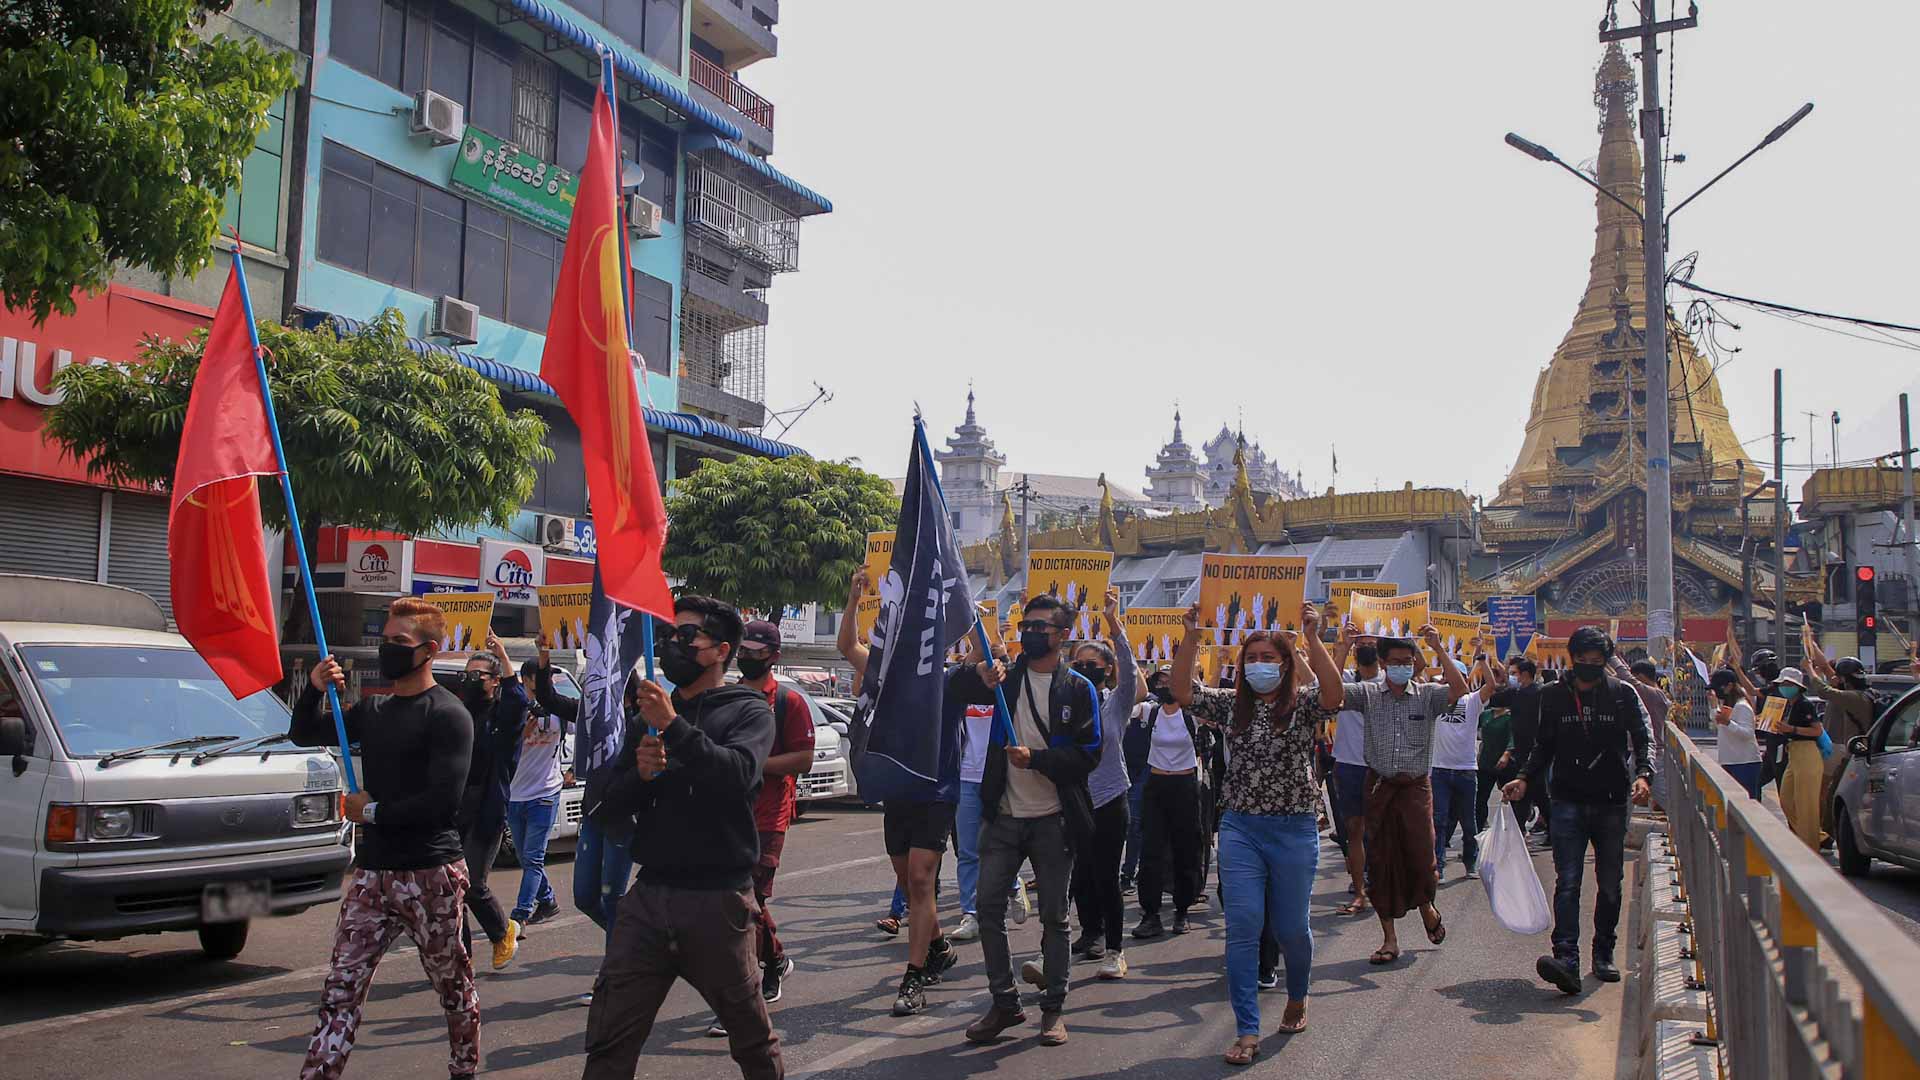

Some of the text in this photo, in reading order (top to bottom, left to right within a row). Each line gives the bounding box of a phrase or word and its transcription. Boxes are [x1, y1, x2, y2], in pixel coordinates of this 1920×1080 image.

[868, 540, 880, 553] NO
[360, 553, 390, 573] City
[1030, 559, 1110, 571] NO DICTATORSHIP
[496, 561, 533, 590] City
[1204, 564, 1304, 580] NO DICTATORSHIP
[1331, 588, 1342, 598] NO
[1367, 597, 1427, 611] DICTATORSHIP
[1127, 614, 1138, 625] NO
